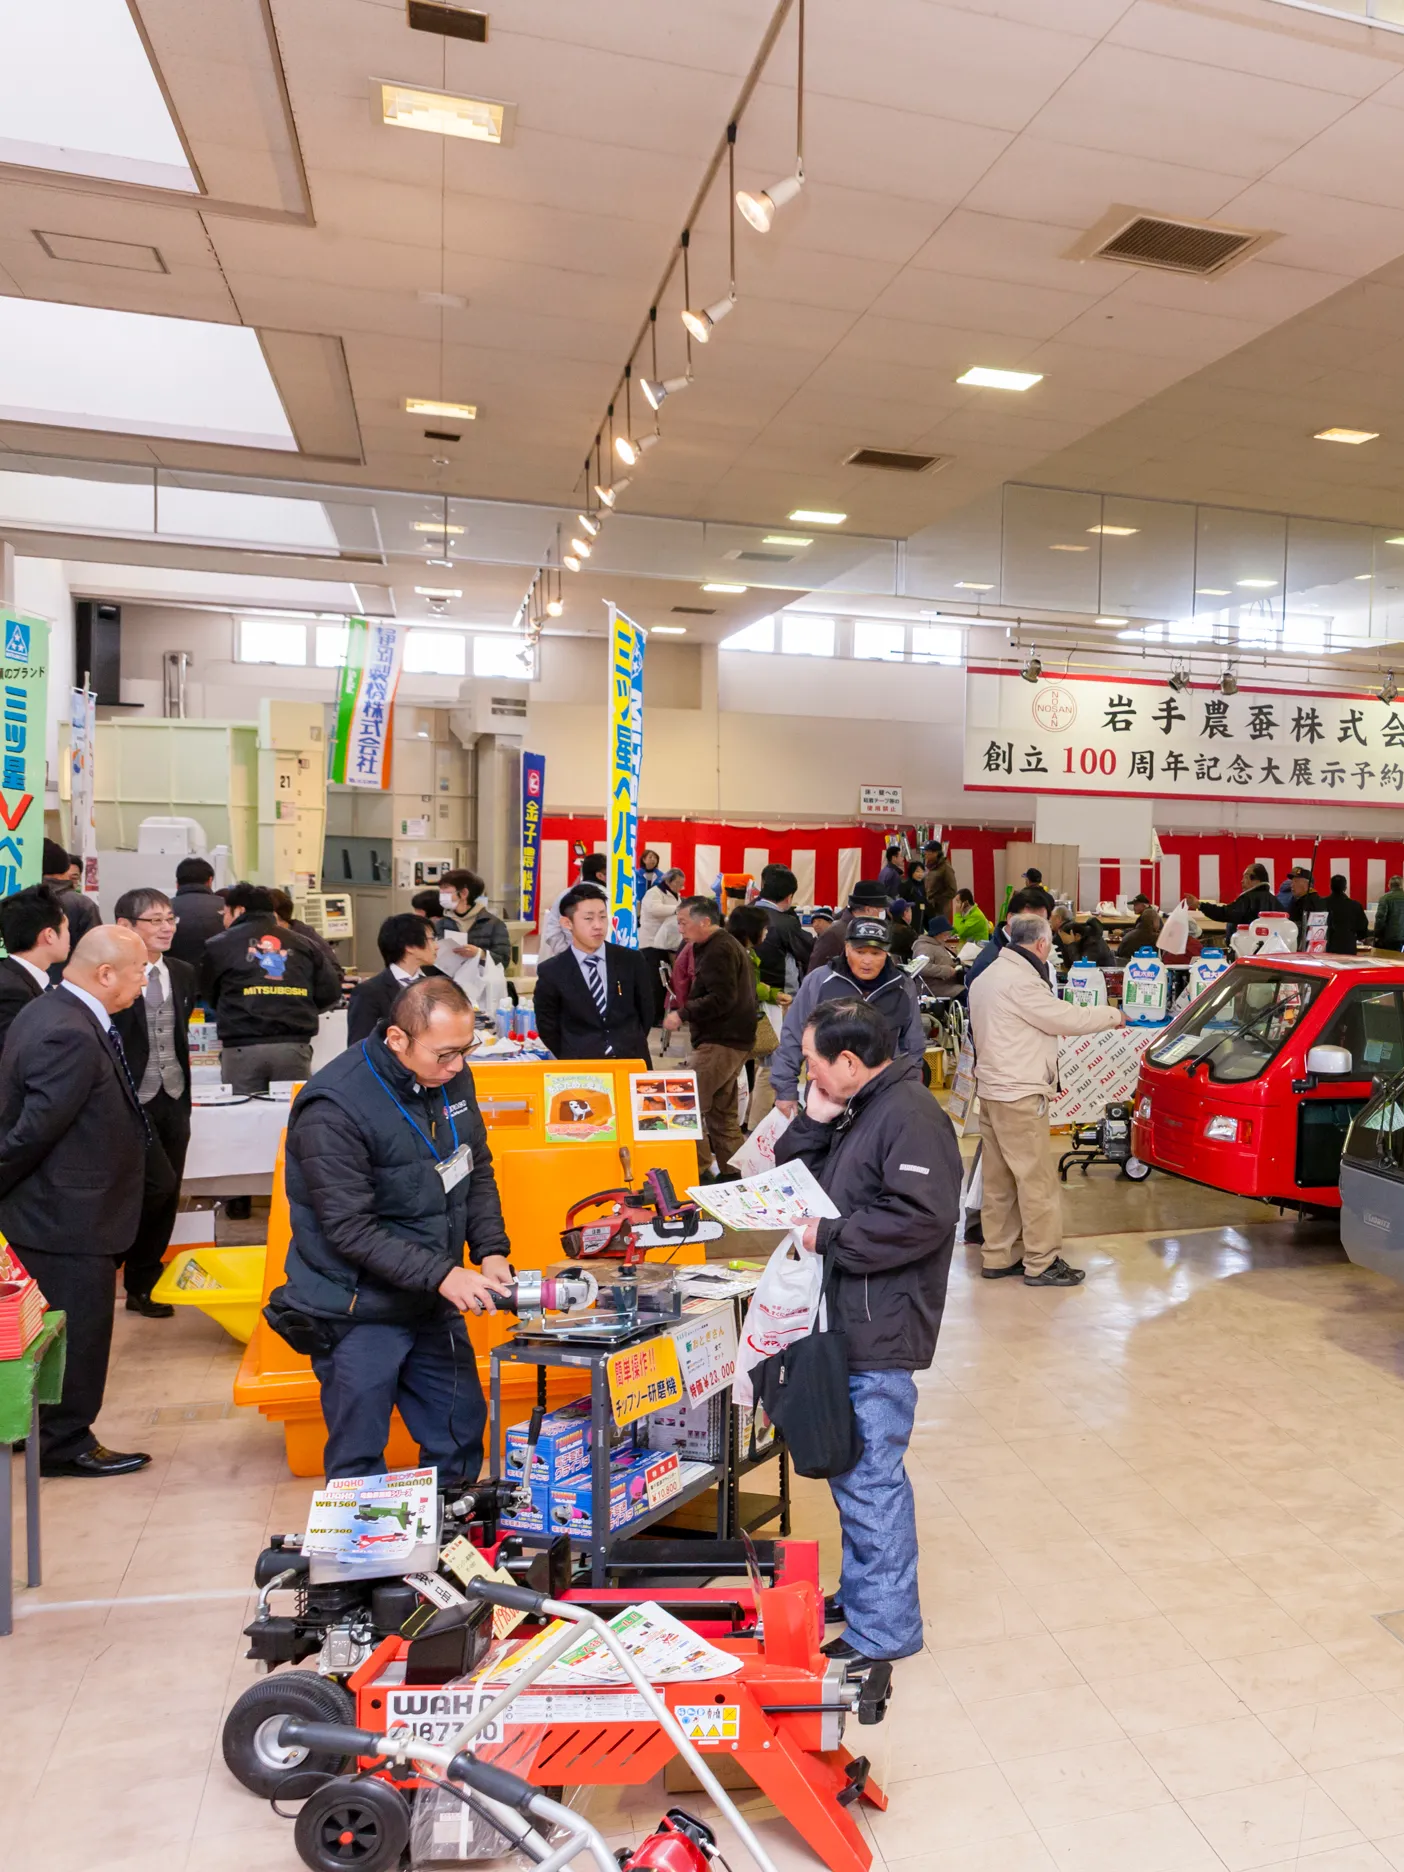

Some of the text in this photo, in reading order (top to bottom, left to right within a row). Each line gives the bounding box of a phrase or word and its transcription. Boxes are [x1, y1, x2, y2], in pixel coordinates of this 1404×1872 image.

[280, 775, 291, 788] 21
[243, 985, 308, 997] MITSUBOSHI
[615, 1376, 678, 1418] チップソー研磨機
[315, 1500, 357, 1508] WB1560
